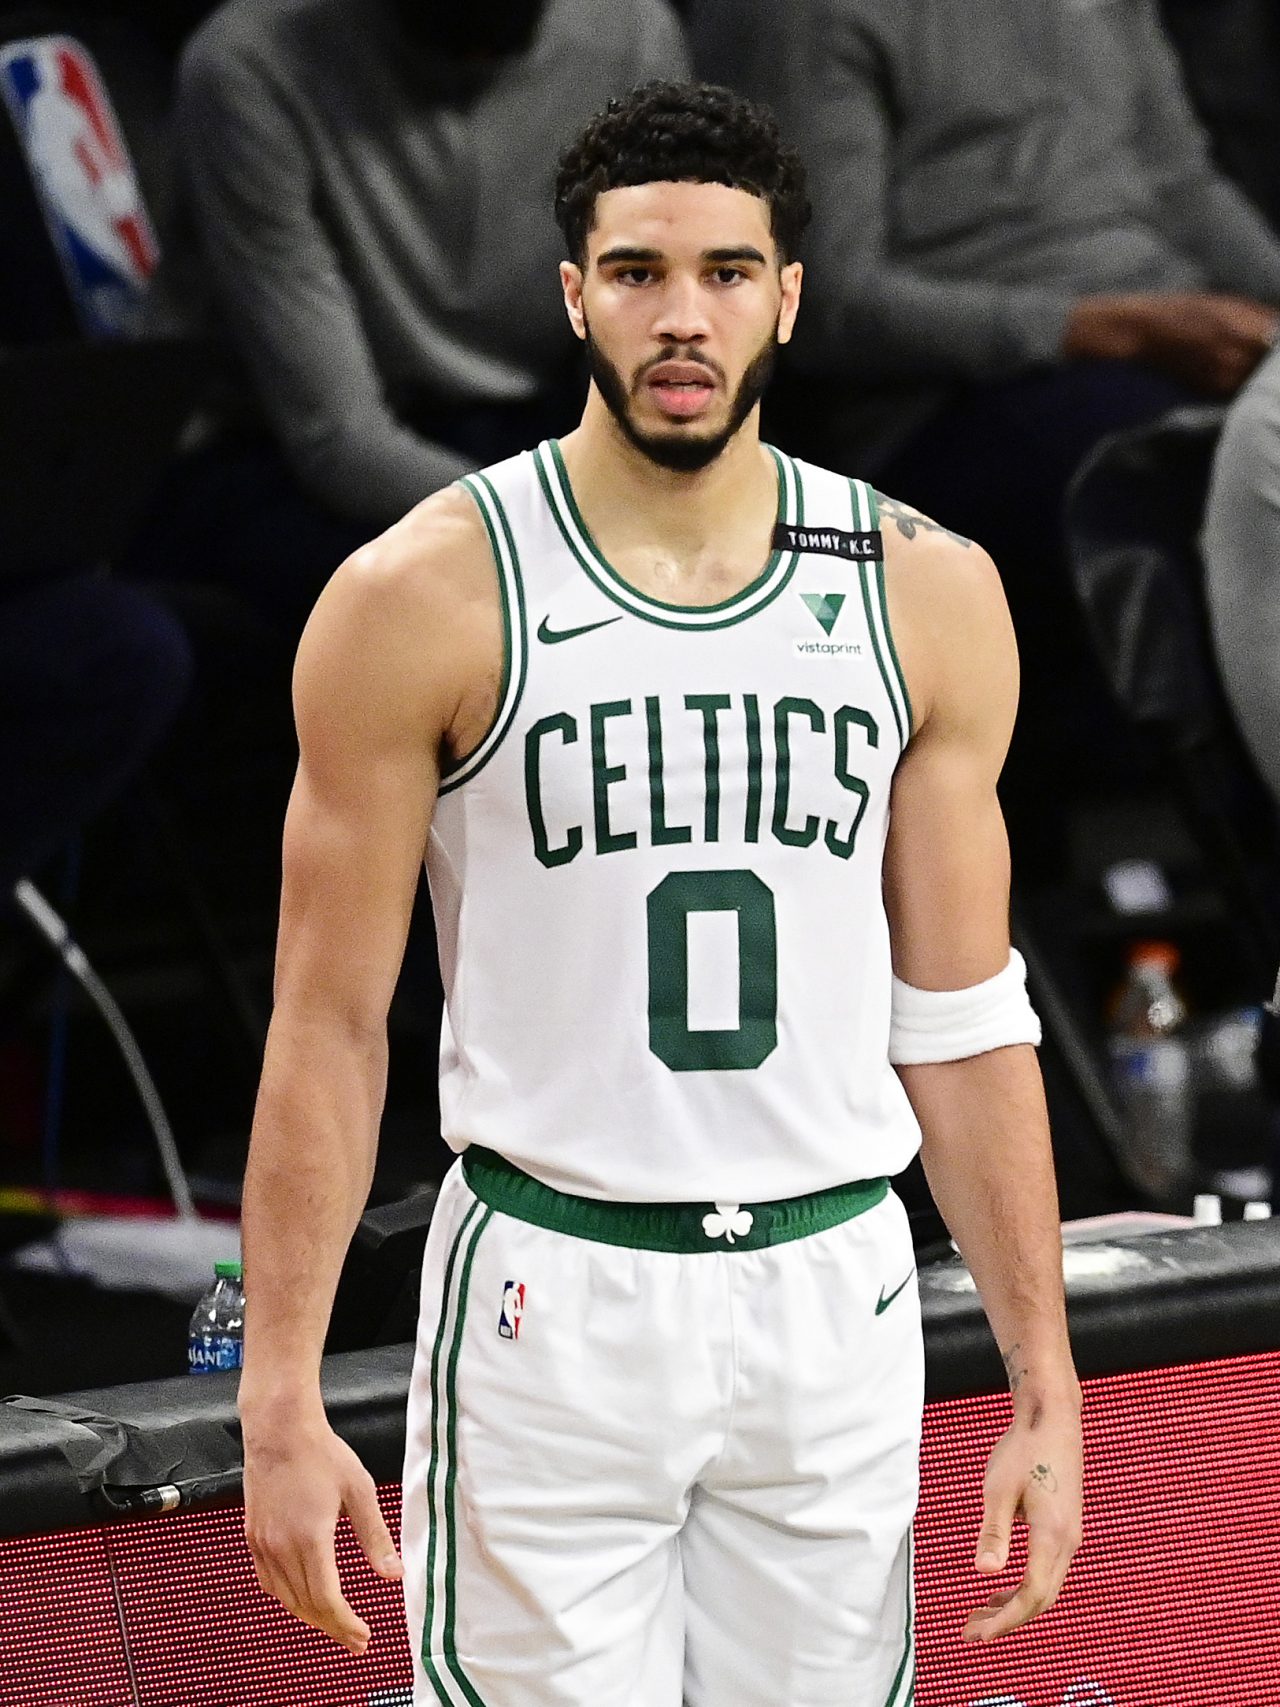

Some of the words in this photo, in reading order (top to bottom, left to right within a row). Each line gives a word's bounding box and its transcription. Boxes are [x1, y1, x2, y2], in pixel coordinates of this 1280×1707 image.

[788, 531, 840, 551] TOMMY
[797, 641, 862, 655] vistaprint
[525, 693, 880, 869] CELTICS
[647, 869, 778, 1072] 0
